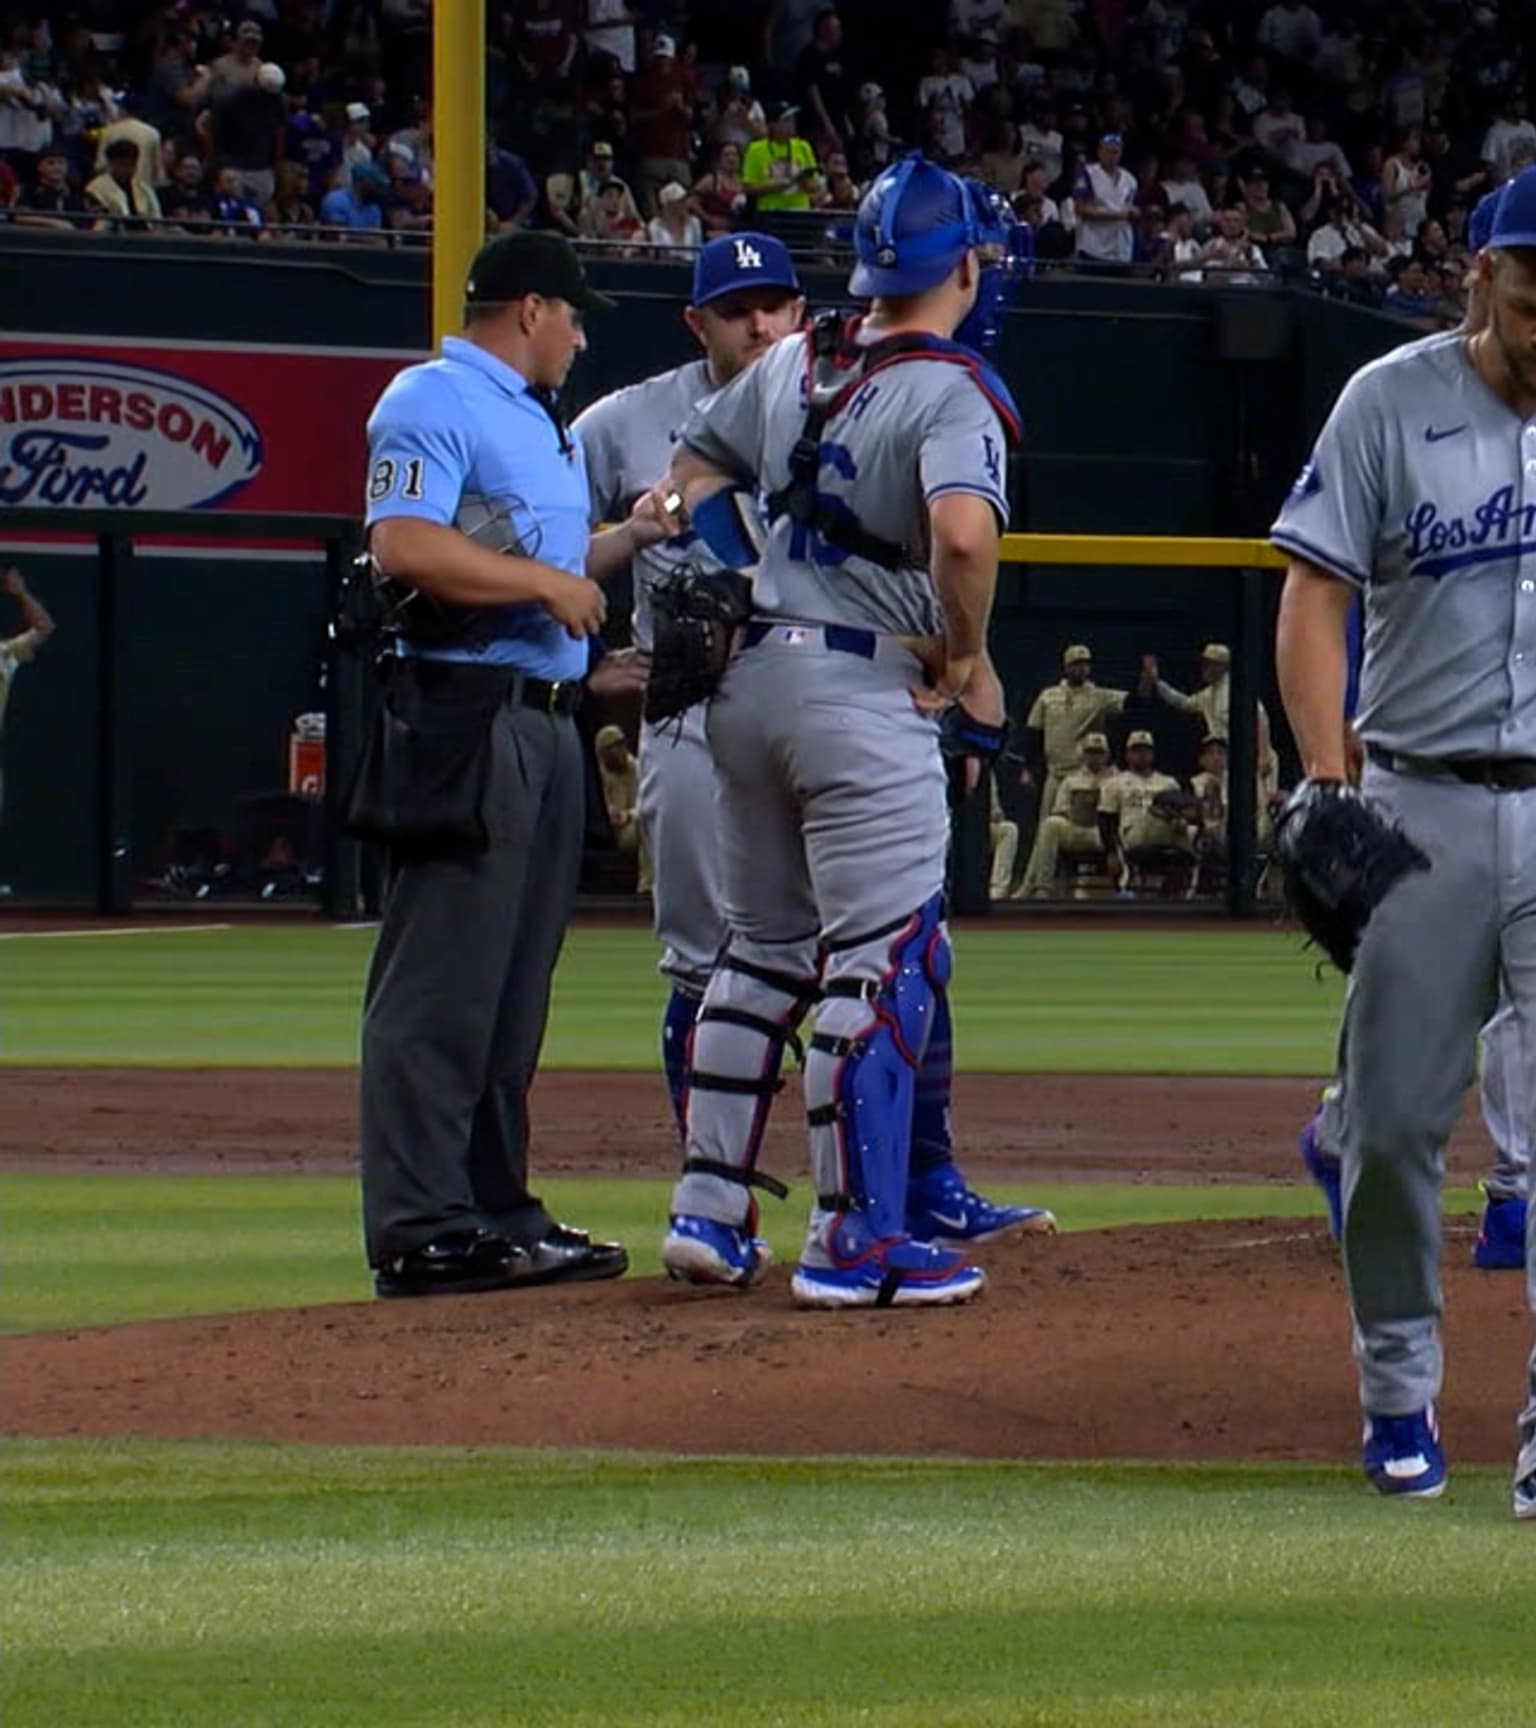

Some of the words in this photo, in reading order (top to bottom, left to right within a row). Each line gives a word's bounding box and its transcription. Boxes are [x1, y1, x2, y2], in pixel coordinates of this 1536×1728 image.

[734, 239, 763, 269] LA
[0, 429, 147, 506] Ford
[367, 457, 423, 501] 81
[1404, 502, 1467, 560] Los
